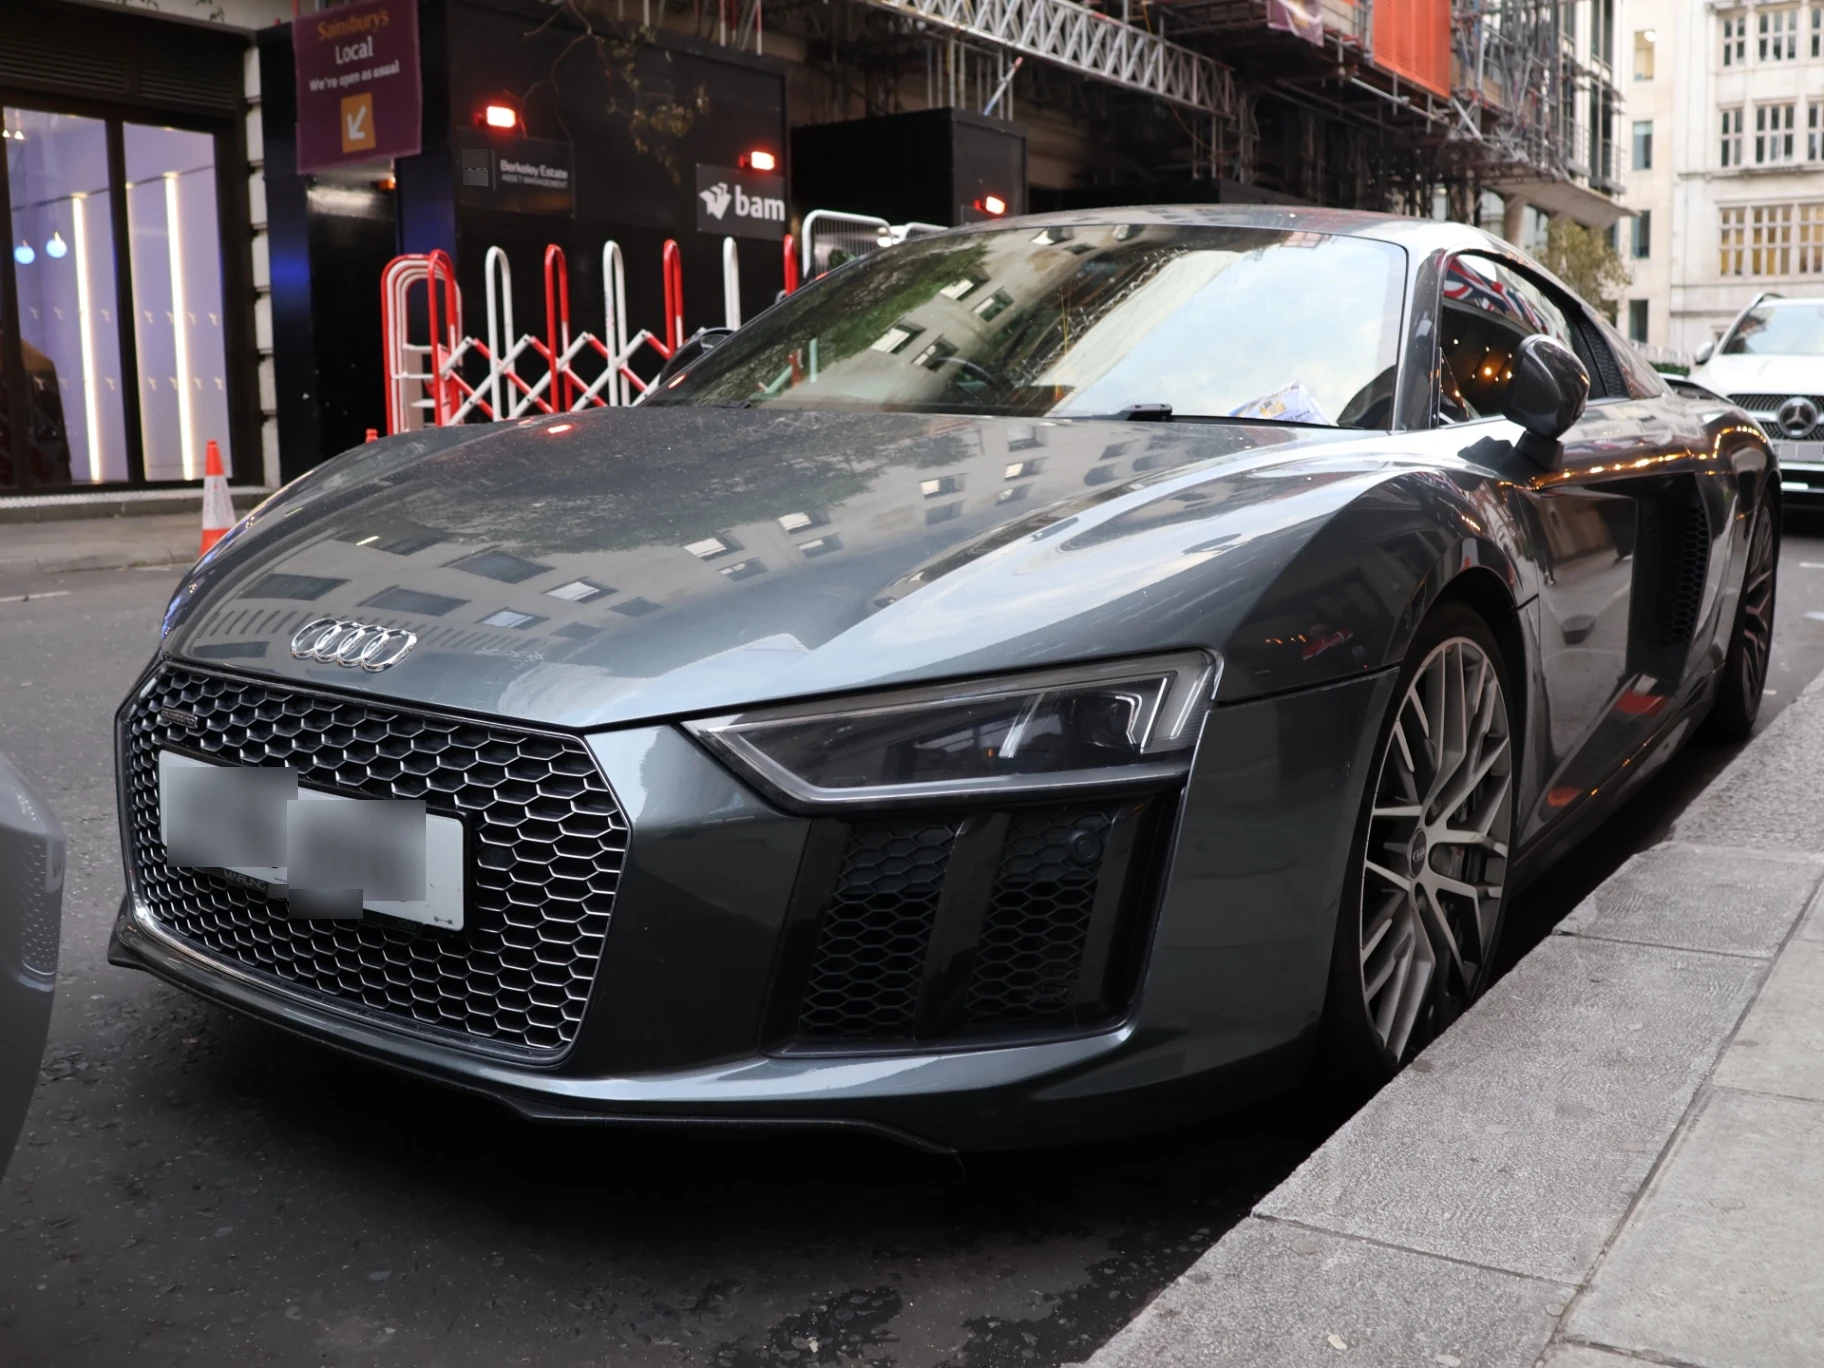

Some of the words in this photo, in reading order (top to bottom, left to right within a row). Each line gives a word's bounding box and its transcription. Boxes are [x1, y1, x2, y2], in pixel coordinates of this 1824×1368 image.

[317, 8, 390, 40] Sainsbury's
[335, 35, 374, 65] Local
[309, 77, 338, 92] We're
[339, 71, 361, 88] open
[361, 68, 373, 81] as
[373, 59, 400, 78] usual
[500, 159, 539, 177] Berkeley
[540, 165, 569, 180] Estate
[735, 184, 786, 221] bam
